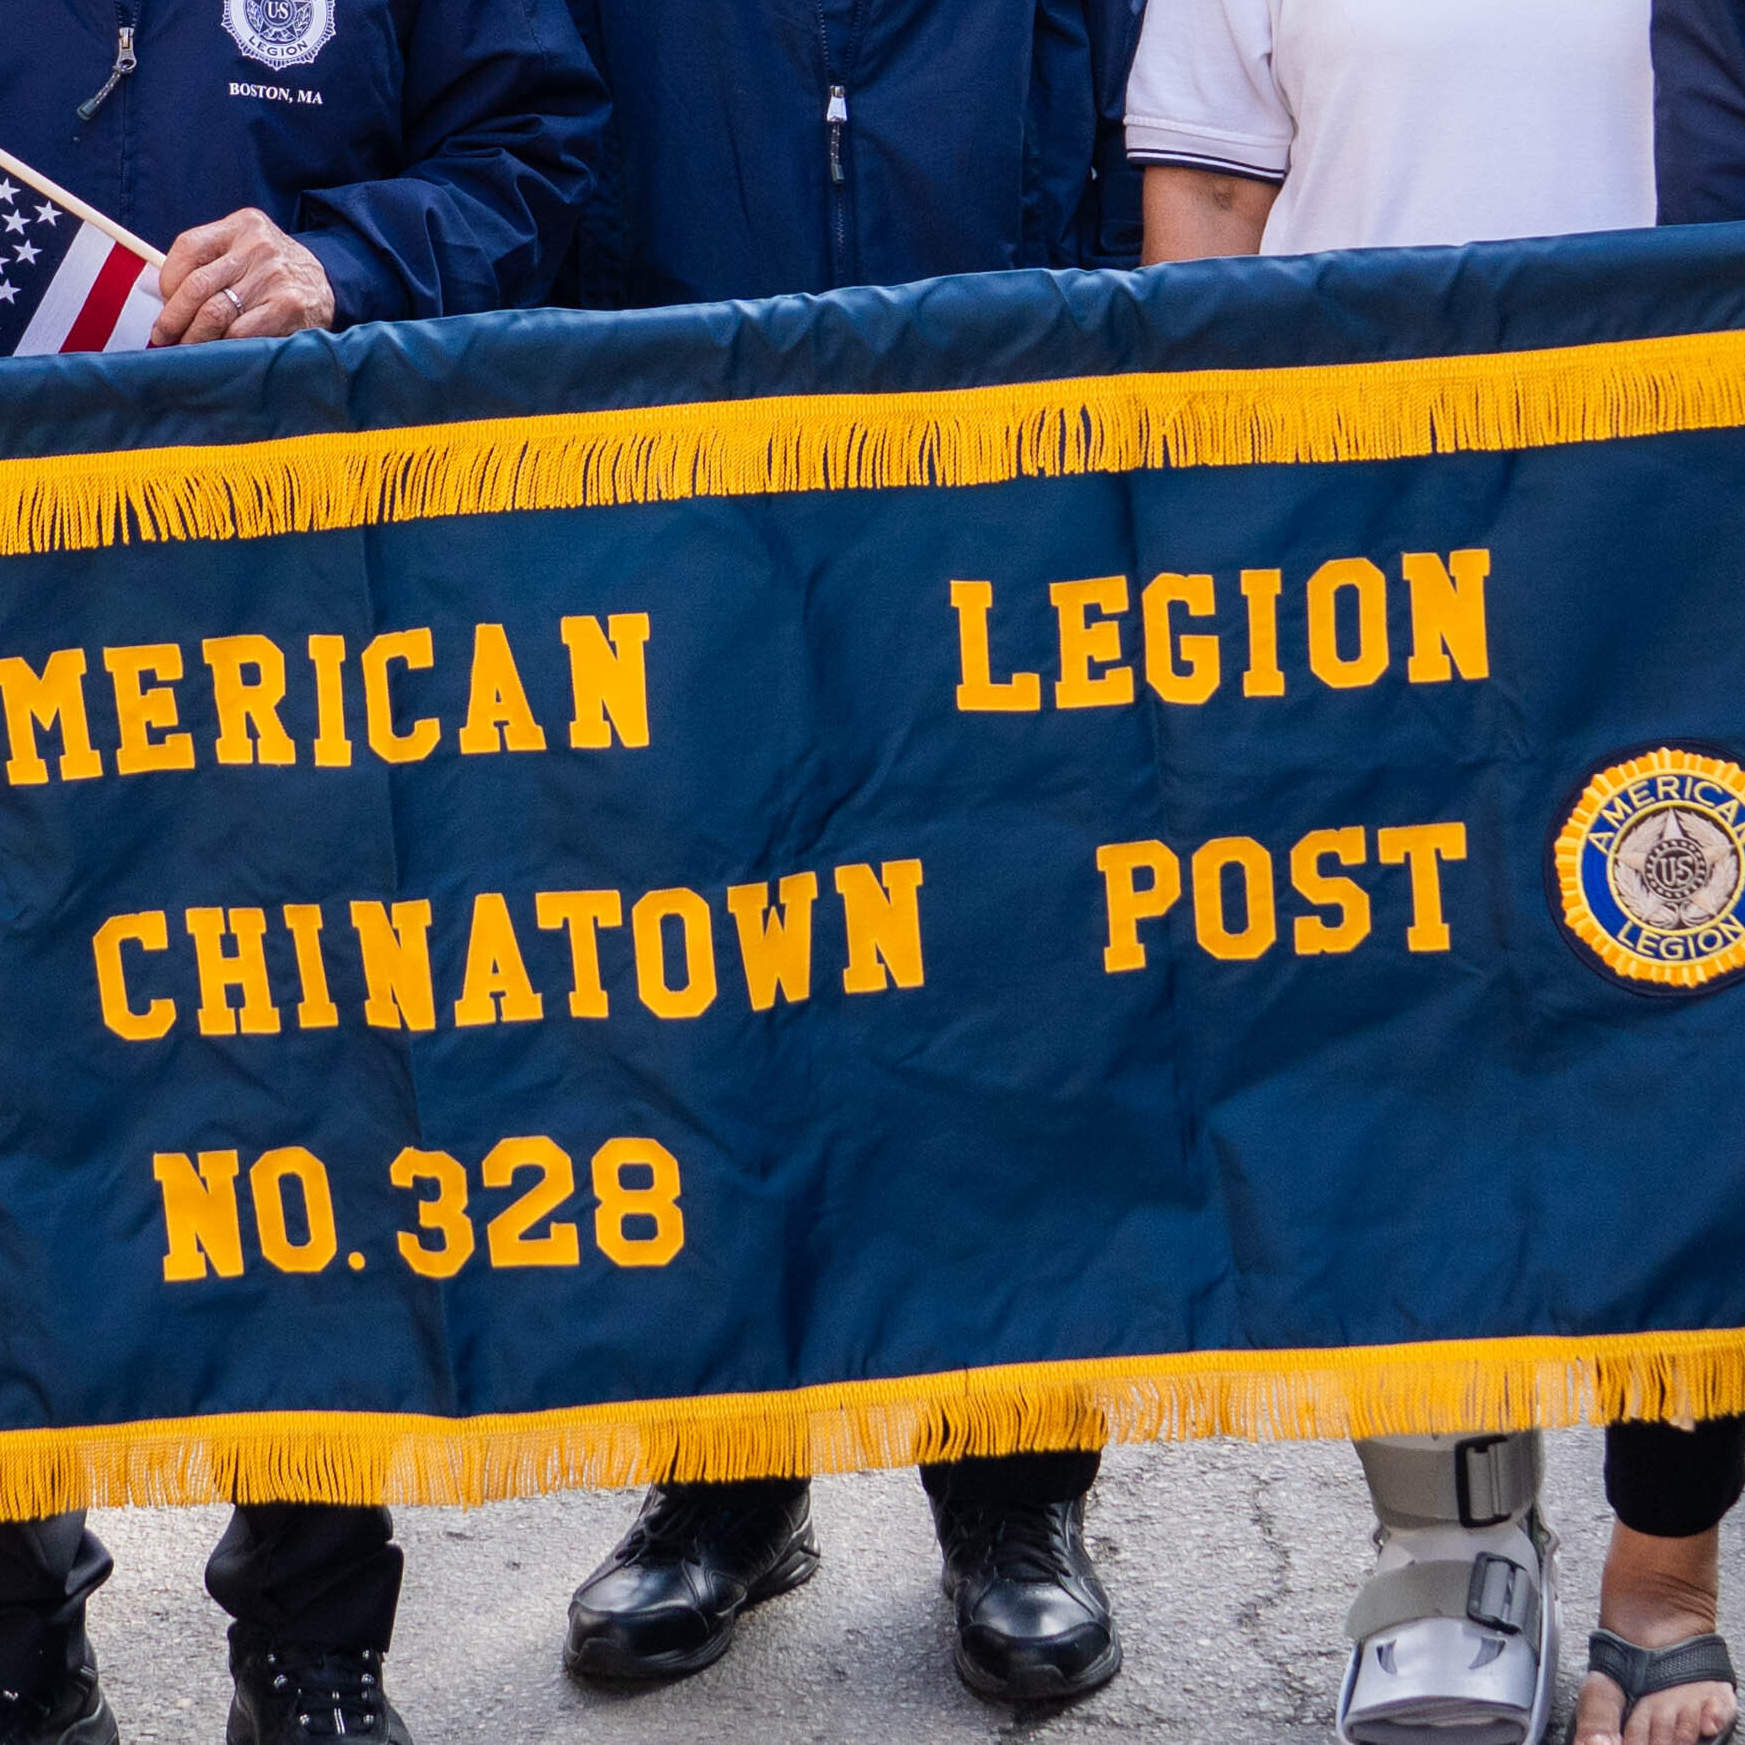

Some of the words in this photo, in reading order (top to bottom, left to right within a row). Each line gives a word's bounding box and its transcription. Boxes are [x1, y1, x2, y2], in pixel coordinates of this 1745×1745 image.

[248, 34, 310, 58] LEGION
[228, 82, 294, 105] BOSTON,
[296, 88, 324, 105] MA
[950, 548, 1492, 713] LEGION
[92, 858, 925, 1042] CHINATOWN
[1096, 822, 1467, 974] POST
[1617, 914, 1745, 960] LEGION
